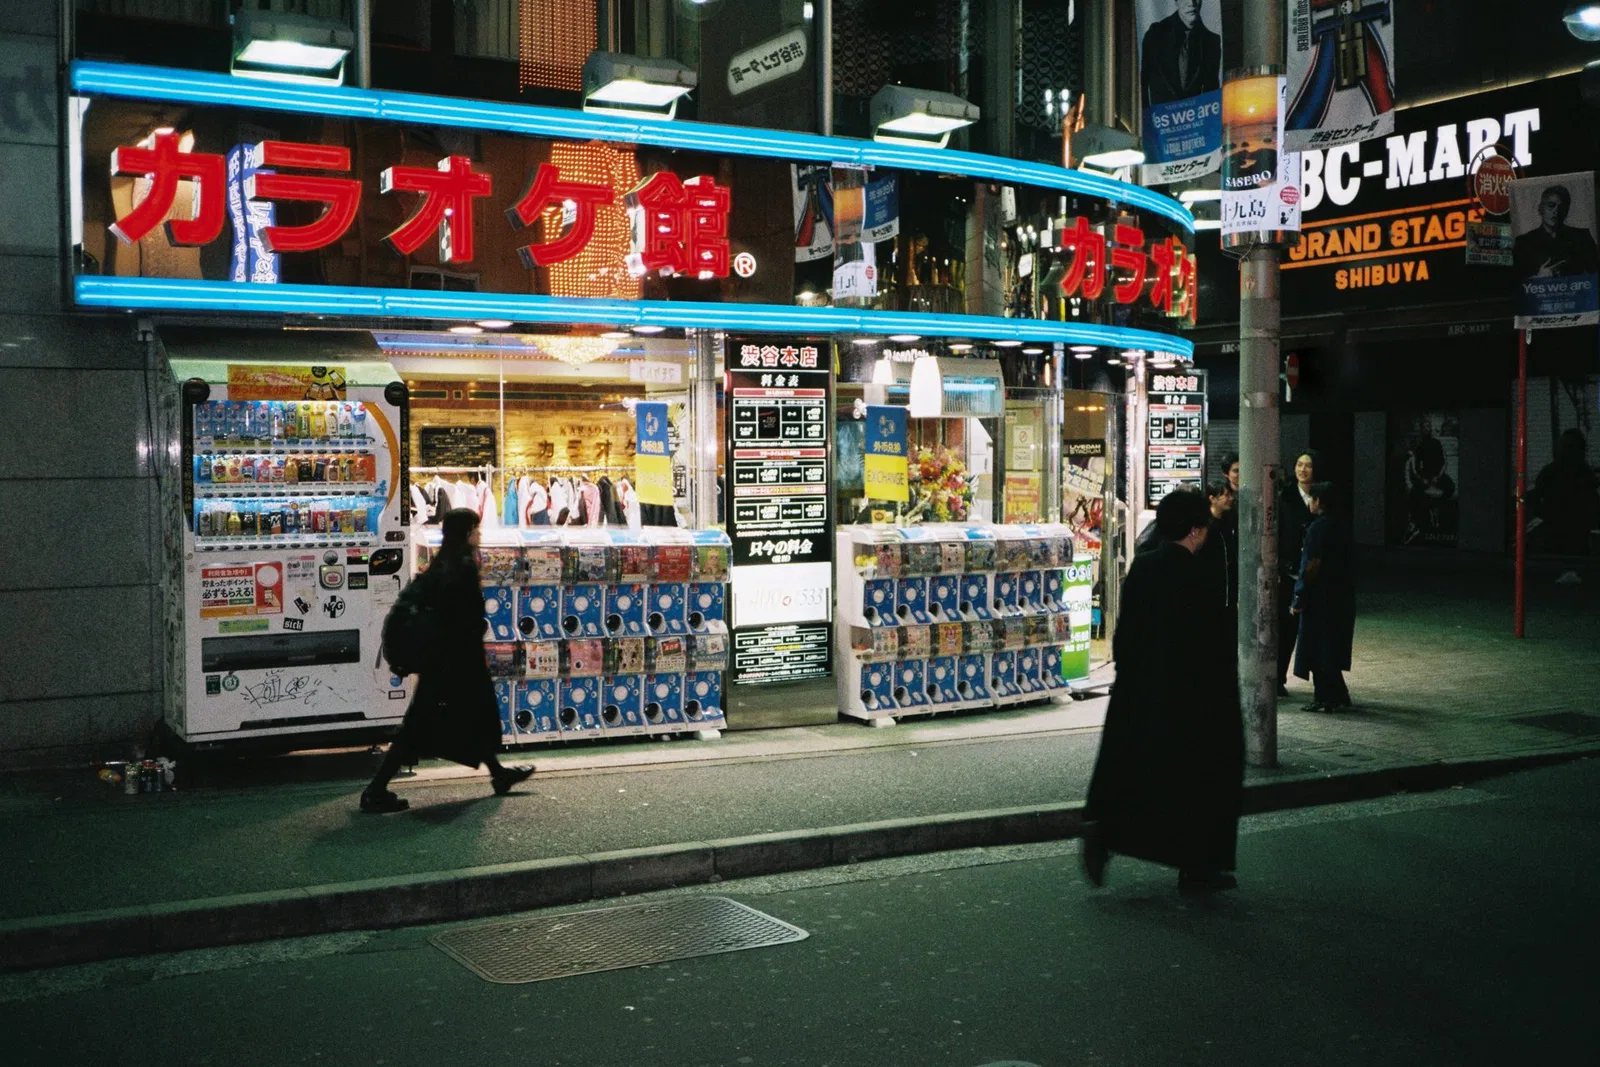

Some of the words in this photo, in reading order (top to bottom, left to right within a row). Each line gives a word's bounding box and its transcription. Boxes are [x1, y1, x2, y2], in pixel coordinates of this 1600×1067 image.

[1297, 17, 1309, 51] BROTHERS
[1171, 109, 1195, 125] we
[1197, 102, 1220, 118] are
[1300, 106, 1541, 212] BC-MART
[1225, 170, 1272, 188] SASEBO
[110, 127, 731, 279] カラオケ館
[1335, 259, 1429, 290] SHIBUYA
[1523, 282, 1546, 294] Yes
[1547, 280, 1568, 293] we
[1570, 278, 1592, 290] are
[1448, 323, 1492, 337] ABC-MART
[740, 345, 818, 367] 渋谷本店
[760, 374, 799, 387] 料金表
[867, 469, 905, 486] EXCHANGE
[749, 539, 813, 556] 只今の料金
[202, 588, 254, 599] 必ずもらえる!
